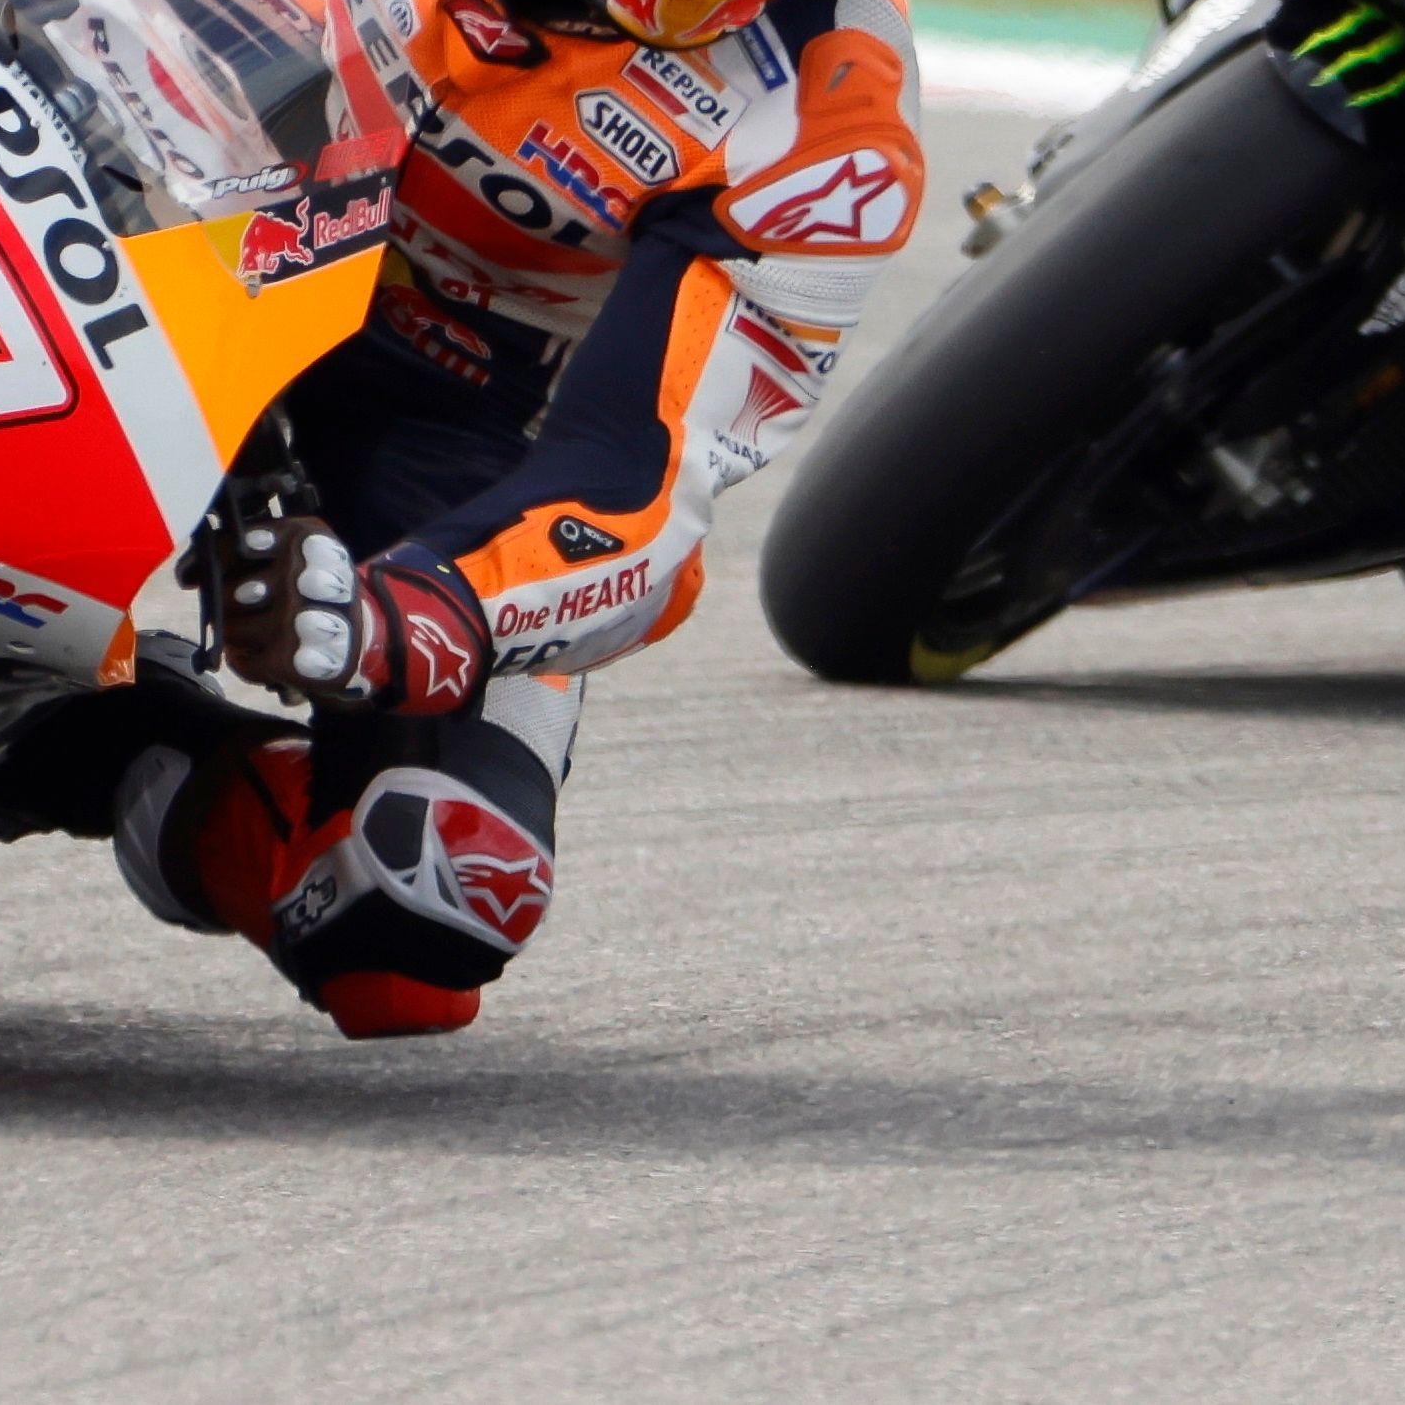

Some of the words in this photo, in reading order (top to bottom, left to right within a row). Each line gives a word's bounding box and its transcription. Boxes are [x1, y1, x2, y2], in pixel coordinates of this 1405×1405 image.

[640, 48, 730, 127] REPSOL
[584, 100, 669, 179] SHOEI
[212, 163, 292, 200] Puig
[494, 602, 551, 638] One
